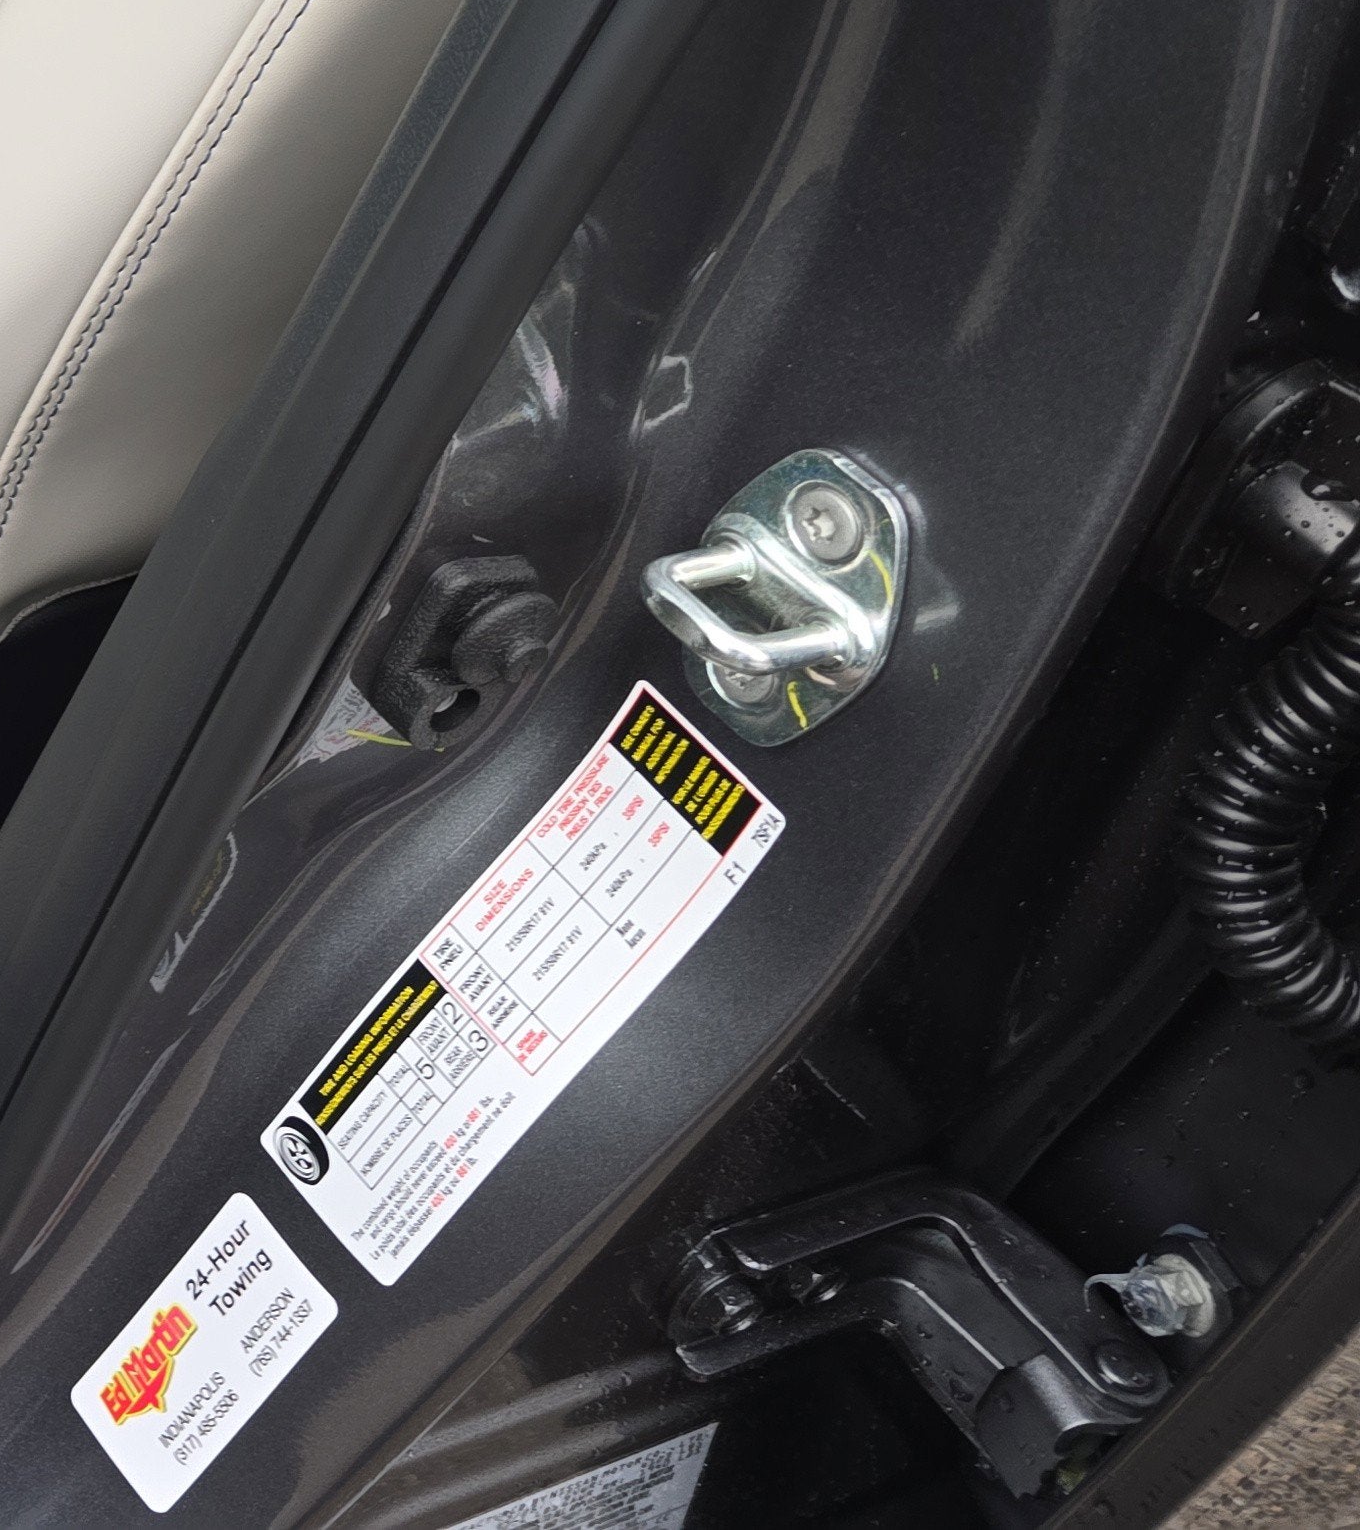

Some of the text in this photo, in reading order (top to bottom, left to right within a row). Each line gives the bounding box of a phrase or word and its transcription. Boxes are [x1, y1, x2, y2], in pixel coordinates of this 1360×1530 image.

[536, 753, 610, 840] COLD TIRE PRESSURE
[558, 779, 602, 832] PRESSION DES
[565, 815, 588, 841] PNEUS
[474, 867, 534, 932] DIMENSIONS
[482, 878, 507, 905] SIZE
[614, 918, 634, 937] None
[624, 927, 646, 949] Aucun
[431, 936, 454, 959] TIRE
[438, 944, 463, 971] PNEU
[458, 963, 486, 994] FRONT
[468, 972, 494, 1002] AVANT
[441, 1000, 463, 1025] 2
[486, 995, 507, 1017] REAR
[417, 1016, 442, 1045] FRONT
[426, 1026, 450, 1054] AVANT
[467, 1028, 489, 1053] 3
[413, 1055, 436, 1080] 5
[444, 1044, 462, 1065] REAR
[388, 1064, 410, 1087] TOTAL
[411, 1091, 434, 1114] TOTAL
[336, 1090, 387, 1150] SEATING CAPACITY
[360, 1147, 385, 1176] NOMBRE
[389, 1113, 413, 1141] PLACES
[377, 1231, 396, 1254] poids
[390, 1214, 408, 1234] total
[414, 1171, 446, 1207] occupants
[456, 1114, 495, 1157] chargement
[498, 1090, 516, 1109] doit
[350, 1227, 365, 1241] The
[361, 1196, 389, 1230] combined
[385, 1176, 406, 1201] weight
[408, 1139, 439, 1174] occupants
[368, 1223, 383, 1240] and
[378, 1208, 397, 1228] cargo
[392, 1185, 414, 1211] should
[409, 1169, 428, 1190] never
[424, 1146, 448, 1173] exceed
[185, 1219, 250, 1300] 24-Hour
[387, 1234, 410, 1260] jamais
[207, 1248, 273, 1316] Towing
[239, 1286, 295, 1354] ANDERSON
[96, 1297, 197, 1422] Ed Martin
[157, 1370, 225, 1448] INDIANAPOLIS
